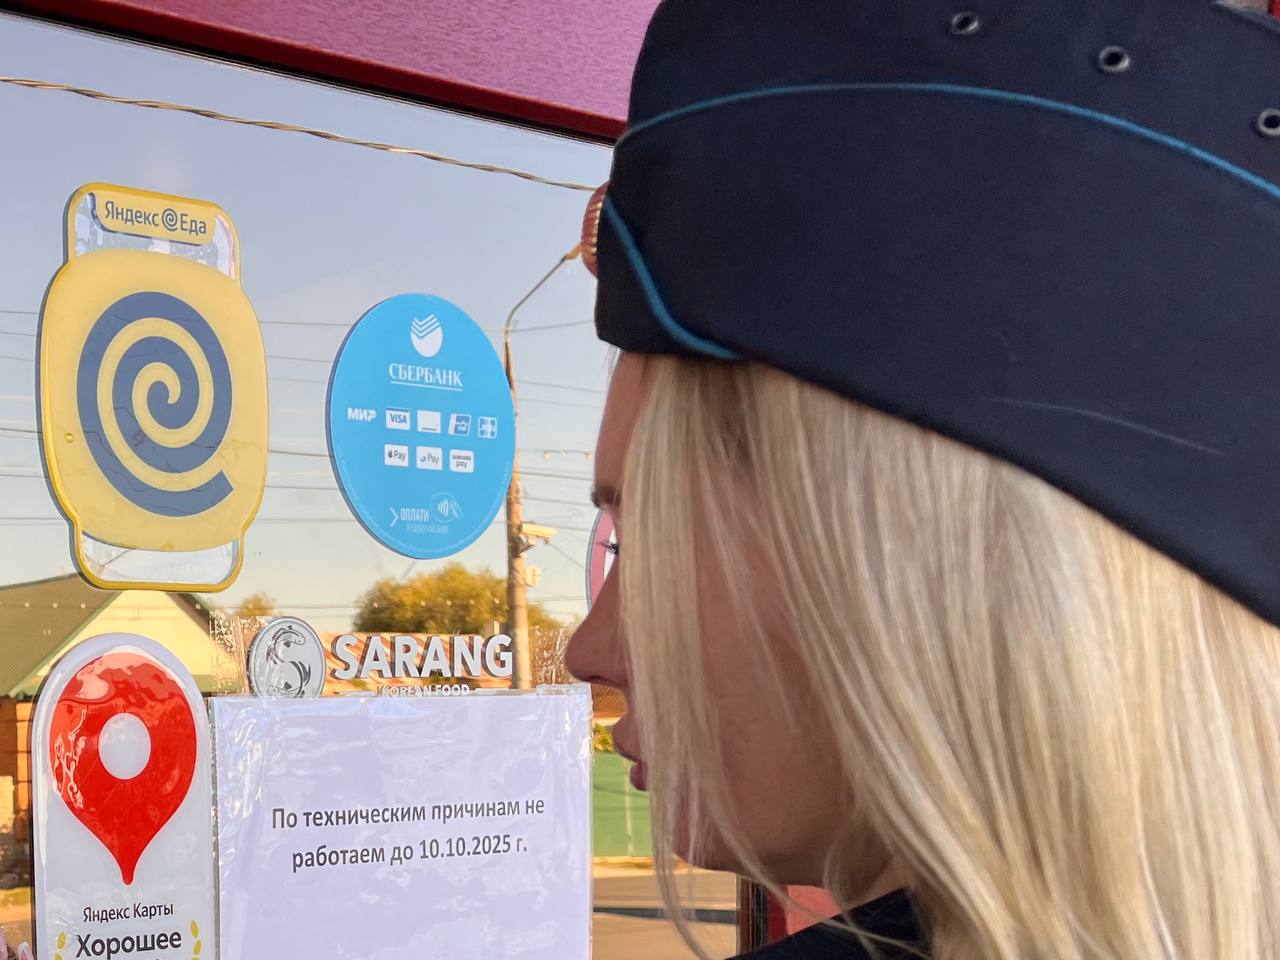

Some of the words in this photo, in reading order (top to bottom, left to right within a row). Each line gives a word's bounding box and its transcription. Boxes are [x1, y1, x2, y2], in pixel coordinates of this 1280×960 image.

[105, 201, 160, 227] Яндекс
[180, 213, 207, 236] Еда
[388, 362, 463, 387] СБЕРБАНК
[347, 407, 377, 422] МИР
[390, 413, 407, 425] VISA
[393, 450, 406, 462] Pay
[427, 453, 439, 465] Pay
[333, 633, 513, 680] SARANG
[379, 684, 432, 698] KOREAN
[435, 684, 470, 696] FOOD
[272, 808, 298, 829] По
[303, 804, 426, 827] техническим
[431, 800, 520, 825] причинам
[525, 799, 545, 815] не
[292, 845, 385, 873] работаем
[390, 844, 414, 866] до
[419, 834, 511, 860] 10.10.2025
[516, 838, 528, 852] г.
[83, 906, 130, 924] Яндекс
[133, 902, 174, 920] Карты
[75, 931, 182, 960] Хорошее
